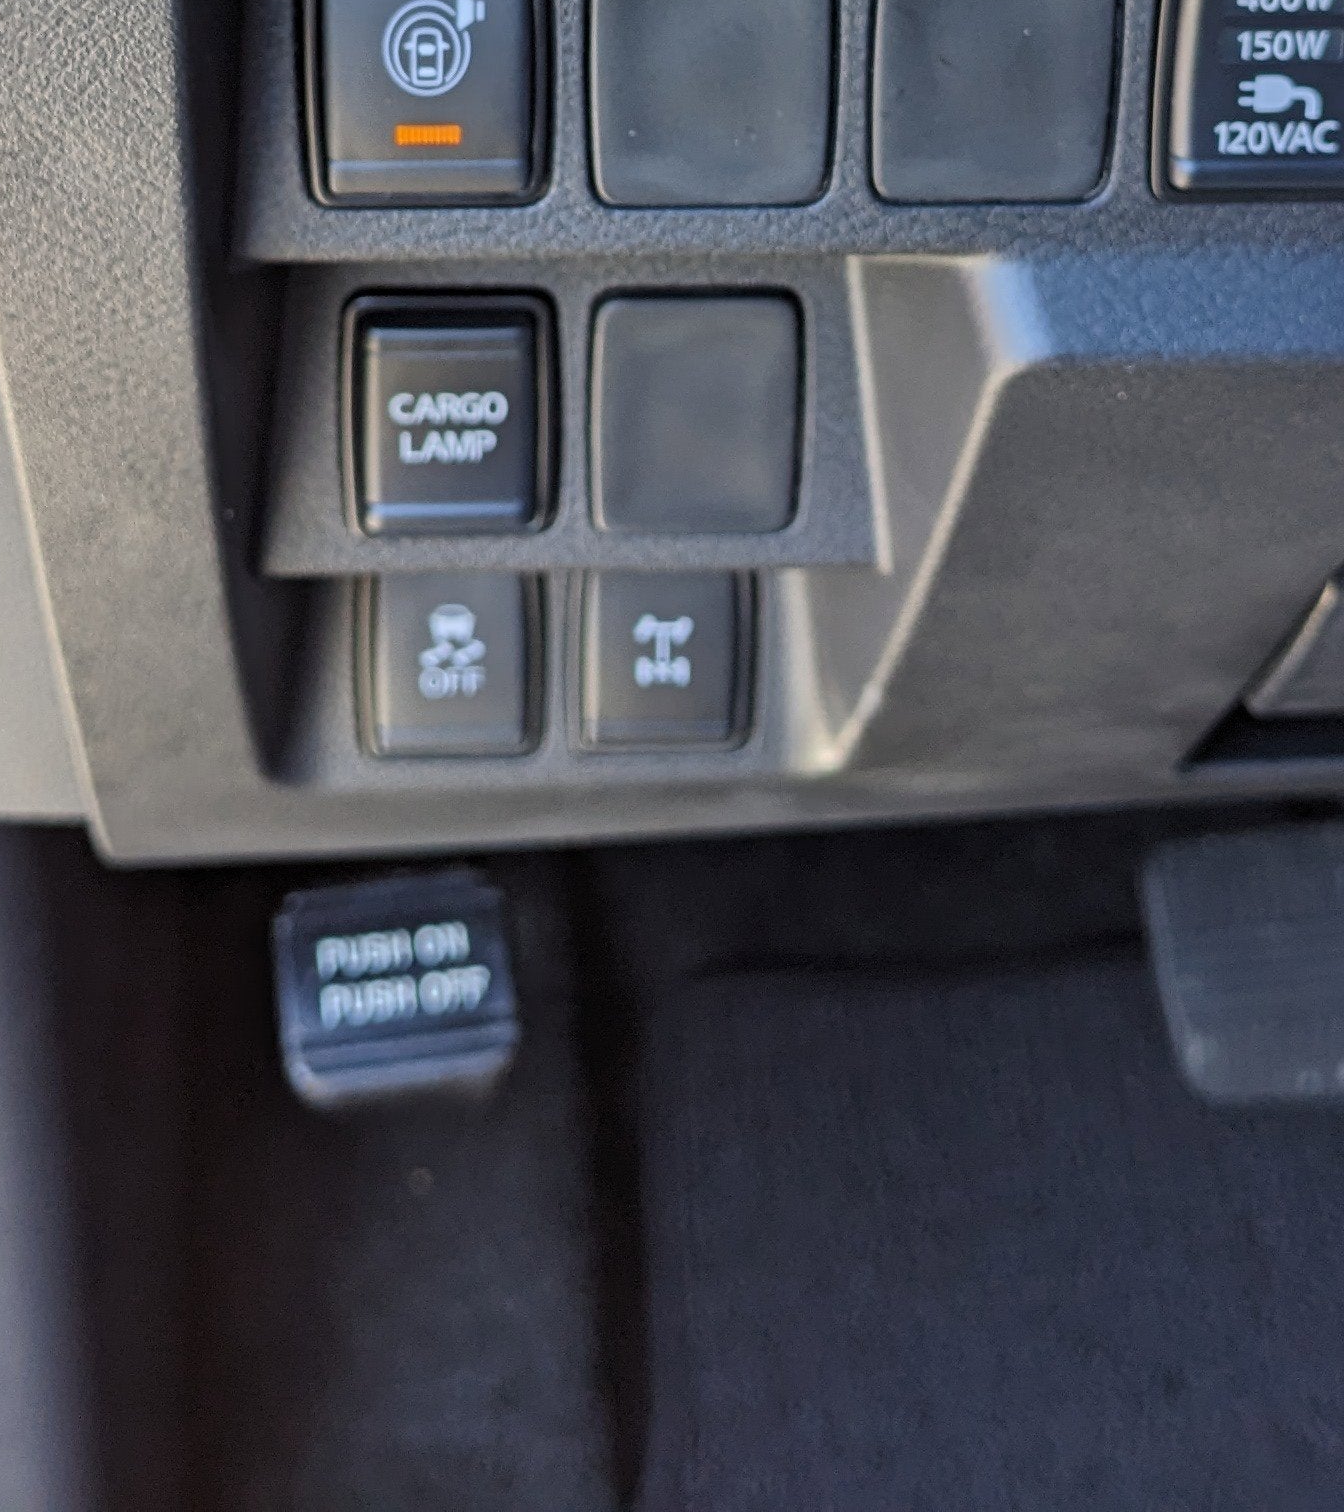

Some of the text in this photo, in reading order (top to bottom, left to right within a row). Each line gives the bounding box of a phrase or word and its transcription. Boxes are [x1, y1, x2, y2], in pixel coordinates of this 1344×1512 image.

[1236, 29, 1332, 61] 150W
[1213, 120, 1342, 155] 120VAC
[388, 391, 509, 426] CARGO
[398, 429, 497, 464] LAMP
[418, 666, 485, 699] OFF
[316, 921, 471, 981] PUSH ON
[320, 964, 492, 1032] PUSH OFF
